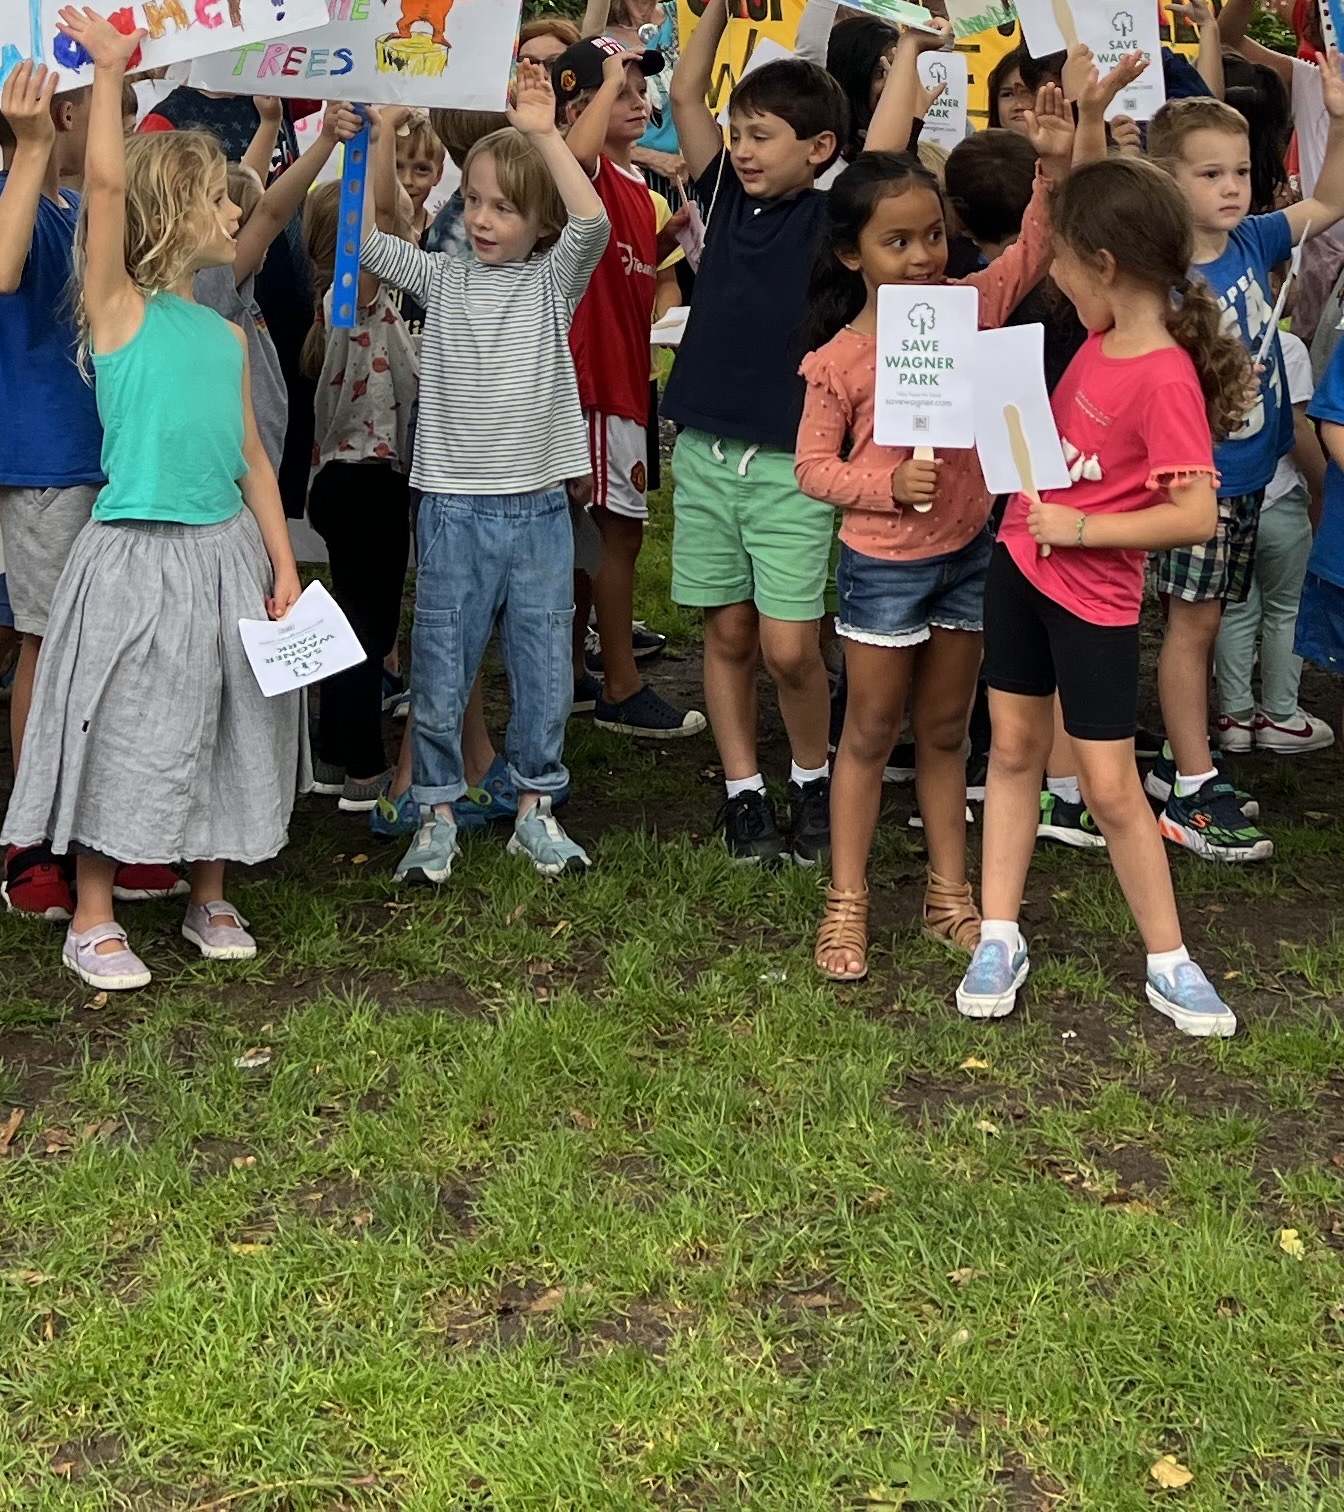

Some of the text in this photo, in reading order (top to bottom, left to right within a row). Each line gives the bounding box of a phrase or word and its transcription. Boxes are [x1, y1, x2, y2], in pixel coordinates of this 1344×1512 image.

[1109, 40, 1138, 50] SAVE
[231, 42, 354, 79] TREES
[927, 109, 950, 118] ARK
[901, 339, 940, 352] SAVE
[885, 355, 955, 370] WAGNER
[899, 373, 940, 386] PARK
[264, 634, 335, 664] WAGNER
[276, 633, 318, 654] PARK
[284, 647, 322, 667] SAVE
